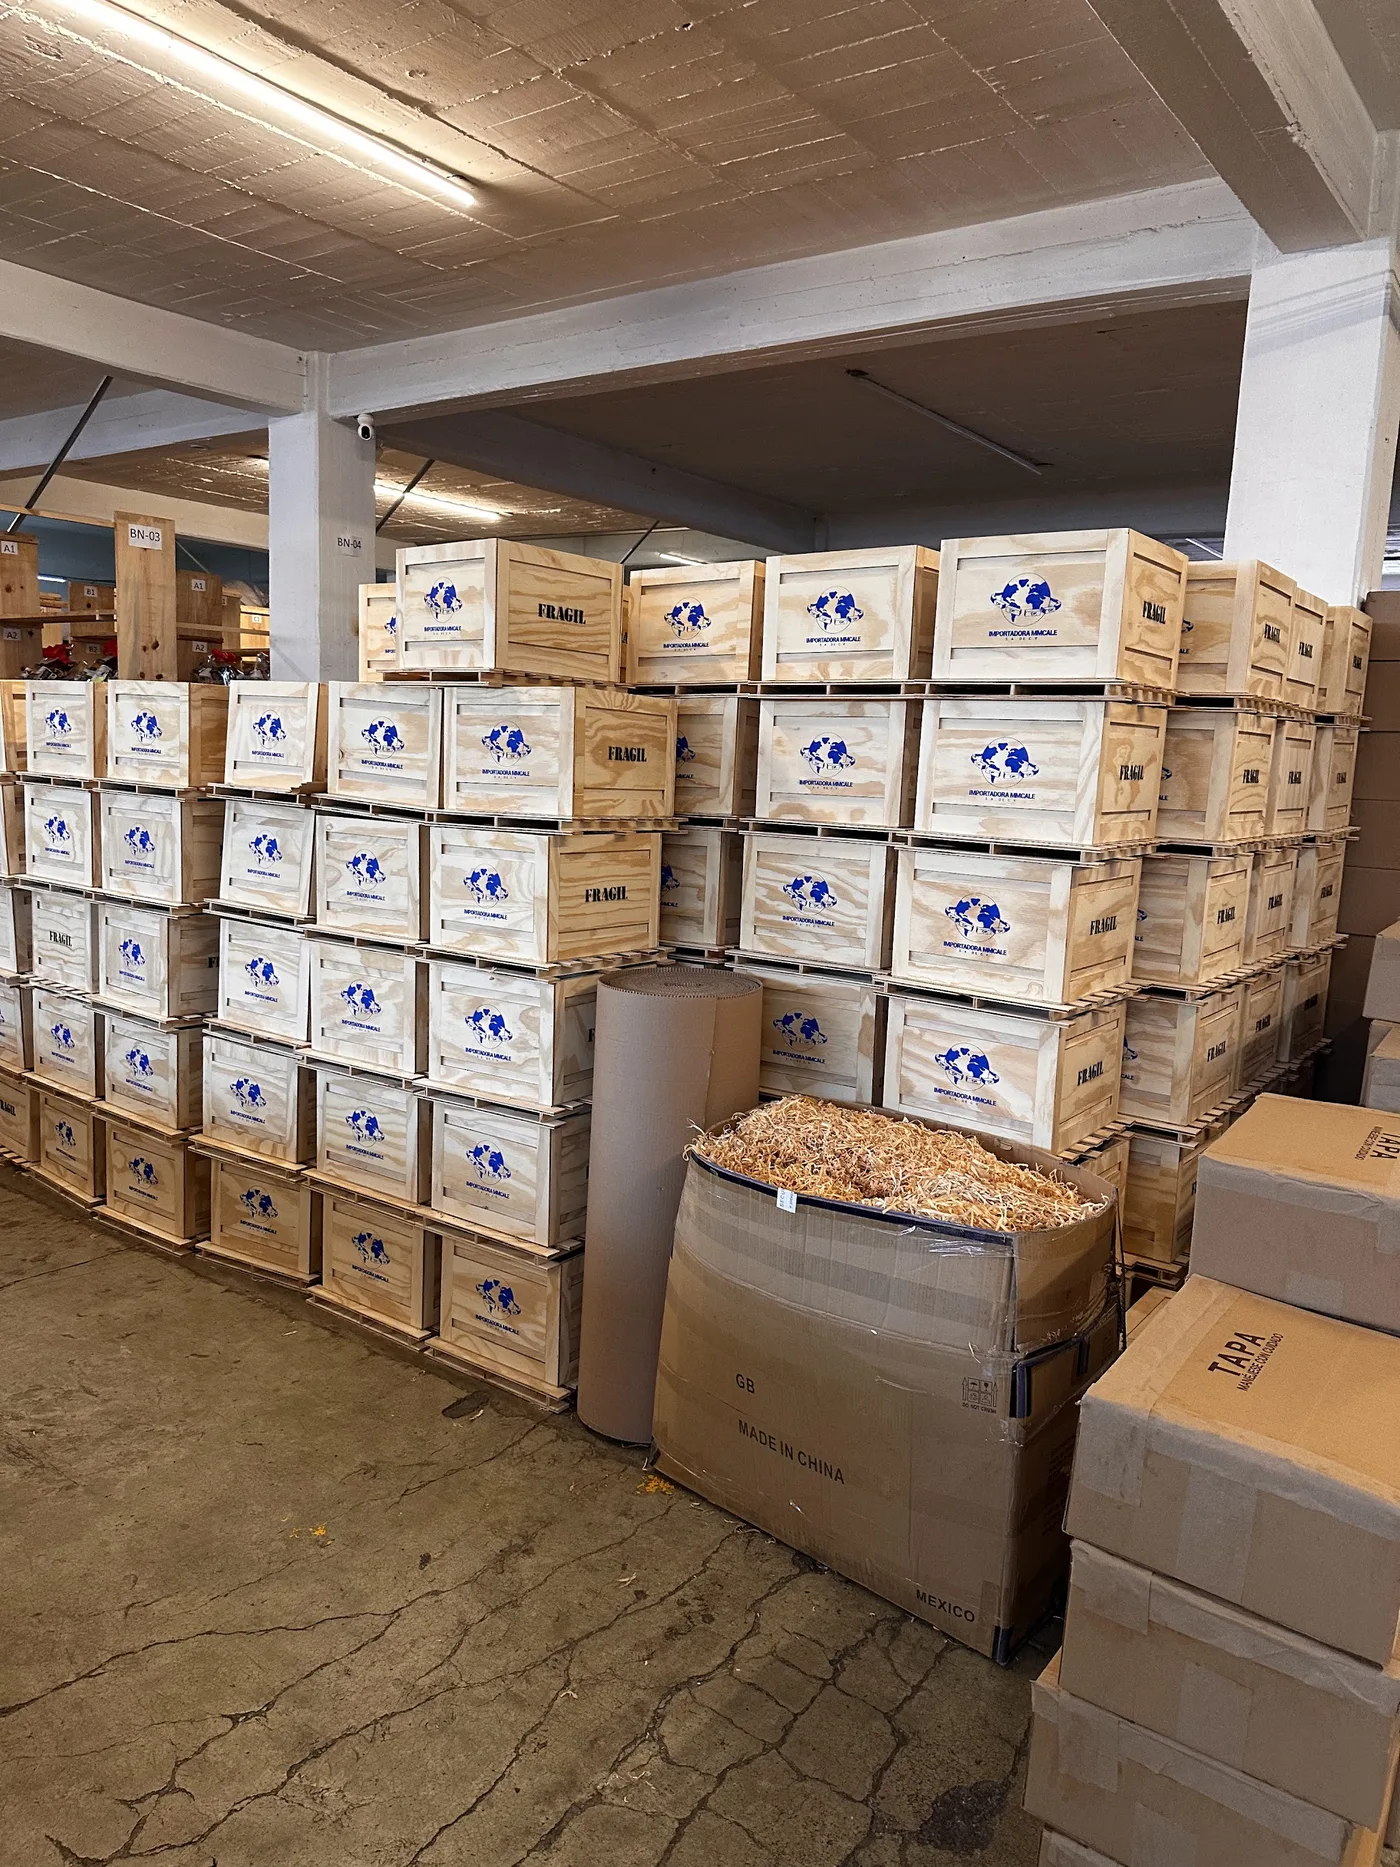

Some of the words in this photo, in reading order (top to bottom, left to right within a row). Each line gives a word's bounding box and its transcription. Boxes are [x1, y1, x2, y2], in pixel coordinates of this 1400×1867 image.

[130, 529, 161, 542] BN-03
[338, 537, 362, 549] BN-04
[4, 545, 15, 553] A1
[194, 582, 203, 590] A1
[538, 603, 586, 625] FRAGIL
[1142, 600, 1166, 625] FRAGIL
[7, 631, 18, 639] A2
[195, 644, 205, 652] A2
[608, 746, 647, 762] FRAGIL
[1119, 764, 1144, 781] FRAGIL
[585, 886, 628, 902] FRAGIL
[1090, 915, 1117, 936] FRAGIL
[50, 930, 72, 947] FRAGIL
[943, 941, 983, 951] IMPORTADORA
[1077, 1060, 1104, 1087] FRAGIL
[933, 1087, 971, 1100] IMPORTADORA
[1261, 1332, 1284, 1354] CUIDADO
[1207, 1332, 1266, 1376] TAPA
[736, 1373, 755, 1394] GB
[739, 1420, 777, 1451] MADE
[781, 1441, 794, 1460] IN
[798, 1450, 845, 1485] CHINA
[916, 1589, 976, 1622] MEXICO
